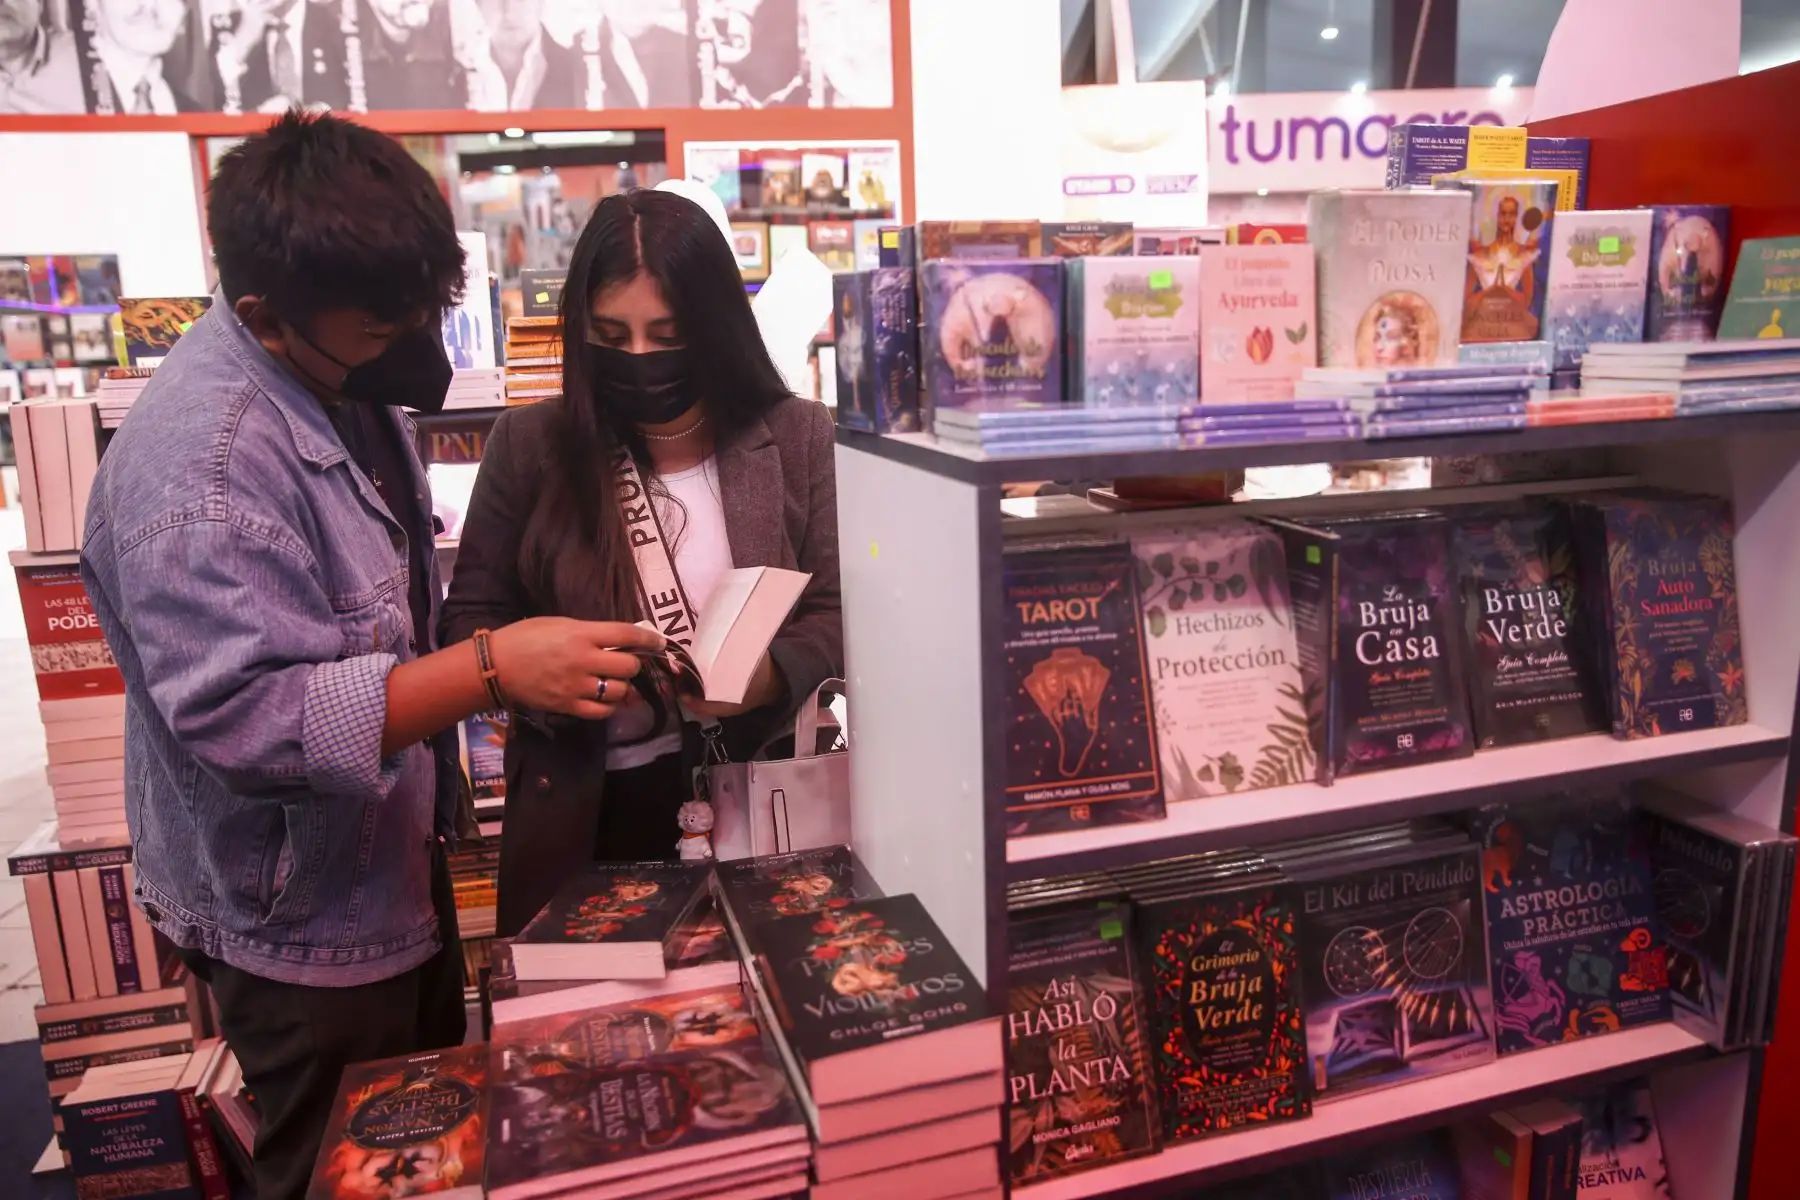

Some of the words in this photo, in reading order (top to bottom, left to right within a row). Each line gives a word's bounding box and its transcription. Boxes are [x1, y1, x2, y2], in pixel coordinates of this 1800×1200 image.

[1219, 105, 1504, 164] tuma
[1385, 220, 1461, 243] PODER
[1219, 291, 1299, 313] Ayurveda
[1648, 557, 1696, 579] Bruja
[1382, 583, 1404, 602] La
[1656, 578, 1695, 598] Auto
[67, 606, 87, 616] DEL
[1016, 597, 1101, 624] TAROT
[1484, 585, 1561, 616] Bruja
[1640, 594, 1714, 617] Sanadora
[47, 613, 100, 632] PODE
[1176, 611, 1265, 636] Hechizos
[1359, 598, 1430, 631] Bruja
[1487, 613, 1567, 645] Verde
[1355, 630, 1440, 666] Casa
[1156, 644, 1286, 680] Protección
[1304, 885, 1325, 914] El
[1331, 883, 1360, 909] Kit
[1367, 873, 1395, 902] del
[1402, 859, 1475, 895] Péndulo
[1522, 902, 1627, 936] PRÁCTICA
[1191, 948, 1260, 972] Grimorio
[1189, 974, 1262, 1004] Bruja
[829, 1018, 900, 1040] CHLOE
[908, 1002, 968, 1022] GONG
[1008, 990, 1117, 1040] HABLÓ
[1194, 998, 1263, 1030] Verde
[1058, 1038, 1077, 1061] la
[1010, 1054, 1131, 1104] PLANTA
[81, 1103, 118, 1117] ROBERT
[120, 1098, 158, 1112] GREENE
[368, 1093, 460, 1117] BESTIAS
[600, 1078, 627, 1139] BESTIAS
[102, 1127, 118, 1137] LAS
[121, 1123, 147, 1135] LEYES
[1071, 1115, 1120, 1133] GAGLIANO
[90, 1137, 165, 1156] NATURALEZA
[103, 1148, 154, 1163] HUMANA
[1577, 1166, 1646, 1189] REATIVA
